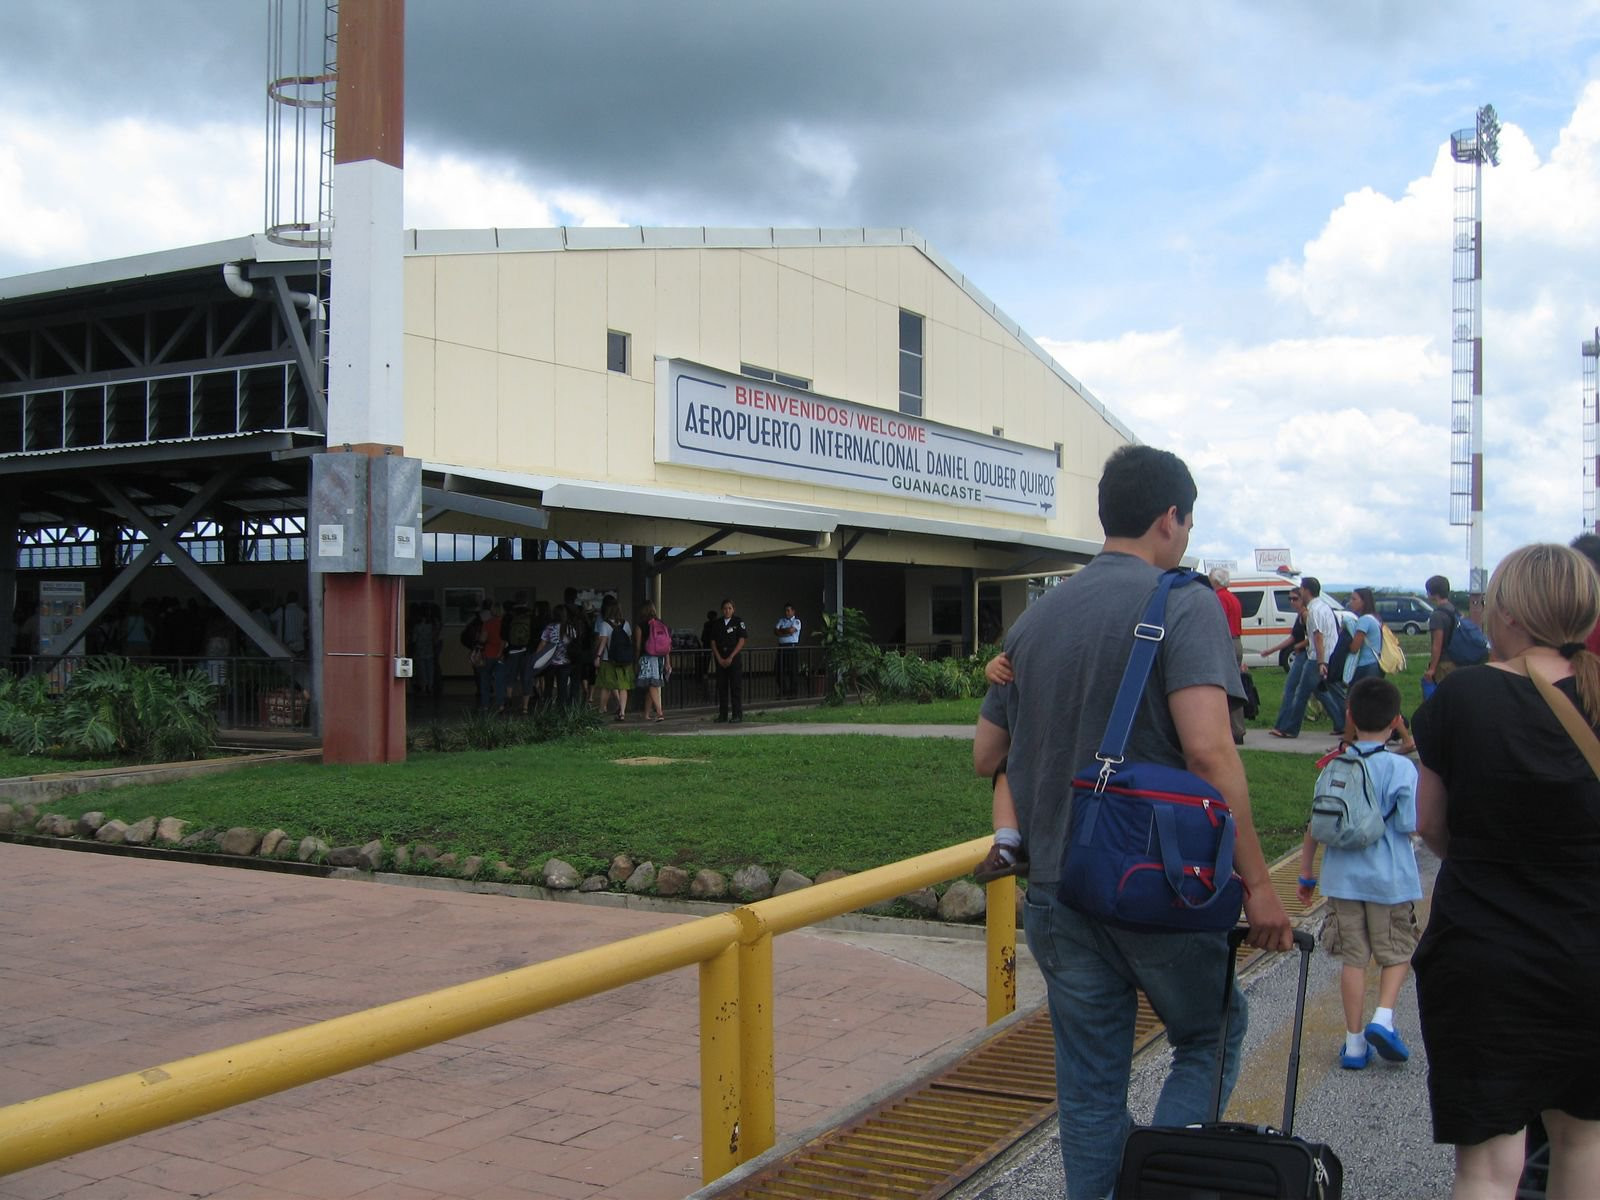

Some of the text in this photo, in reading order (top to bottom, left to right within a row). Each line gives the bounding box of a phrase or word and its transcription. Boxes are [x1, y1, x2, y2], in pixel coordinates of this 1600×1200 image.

[684, 401, 1055, 497] AEROPUERTO INTERNACIONAL DANIEL ODUBER QUIROS
[891, 475, 982, 502] GUANACASTE
